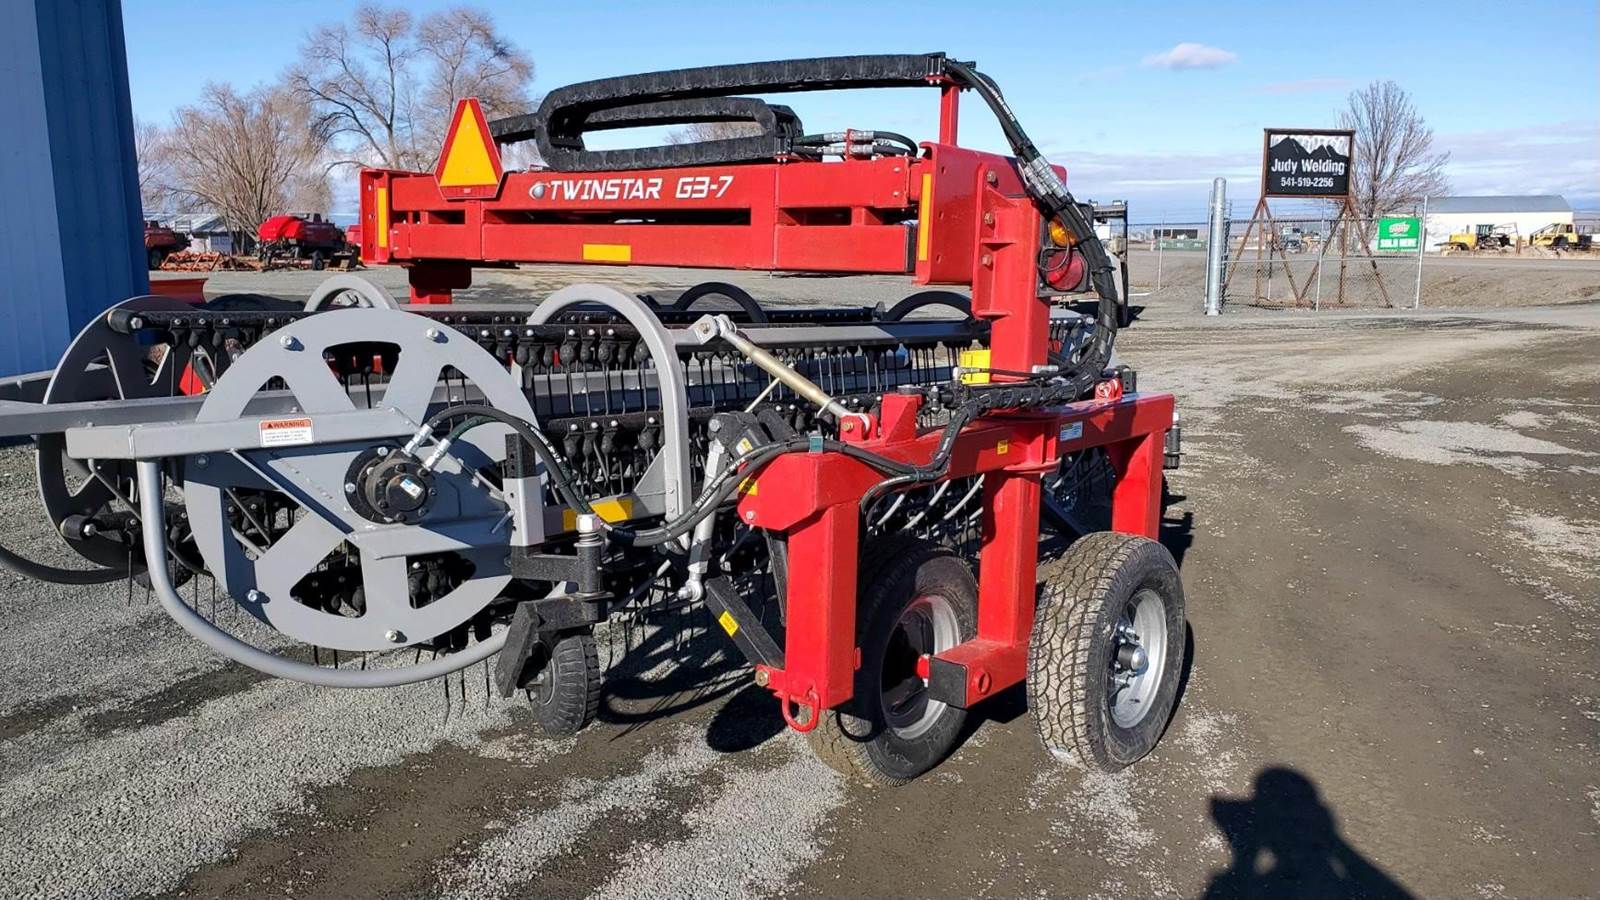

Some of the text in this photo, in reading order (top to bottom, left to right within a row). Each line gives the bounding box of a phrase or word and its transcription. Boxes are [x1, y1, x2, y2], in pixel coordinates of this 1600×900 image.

[1271, 158, 1345, 176] Judy Welding
[550, 175, 734, 200] TWINSTAR G3-7
[1280, 177, 1334, 187] 541-519-2256
[273, 421, 305, 429] WARNING
